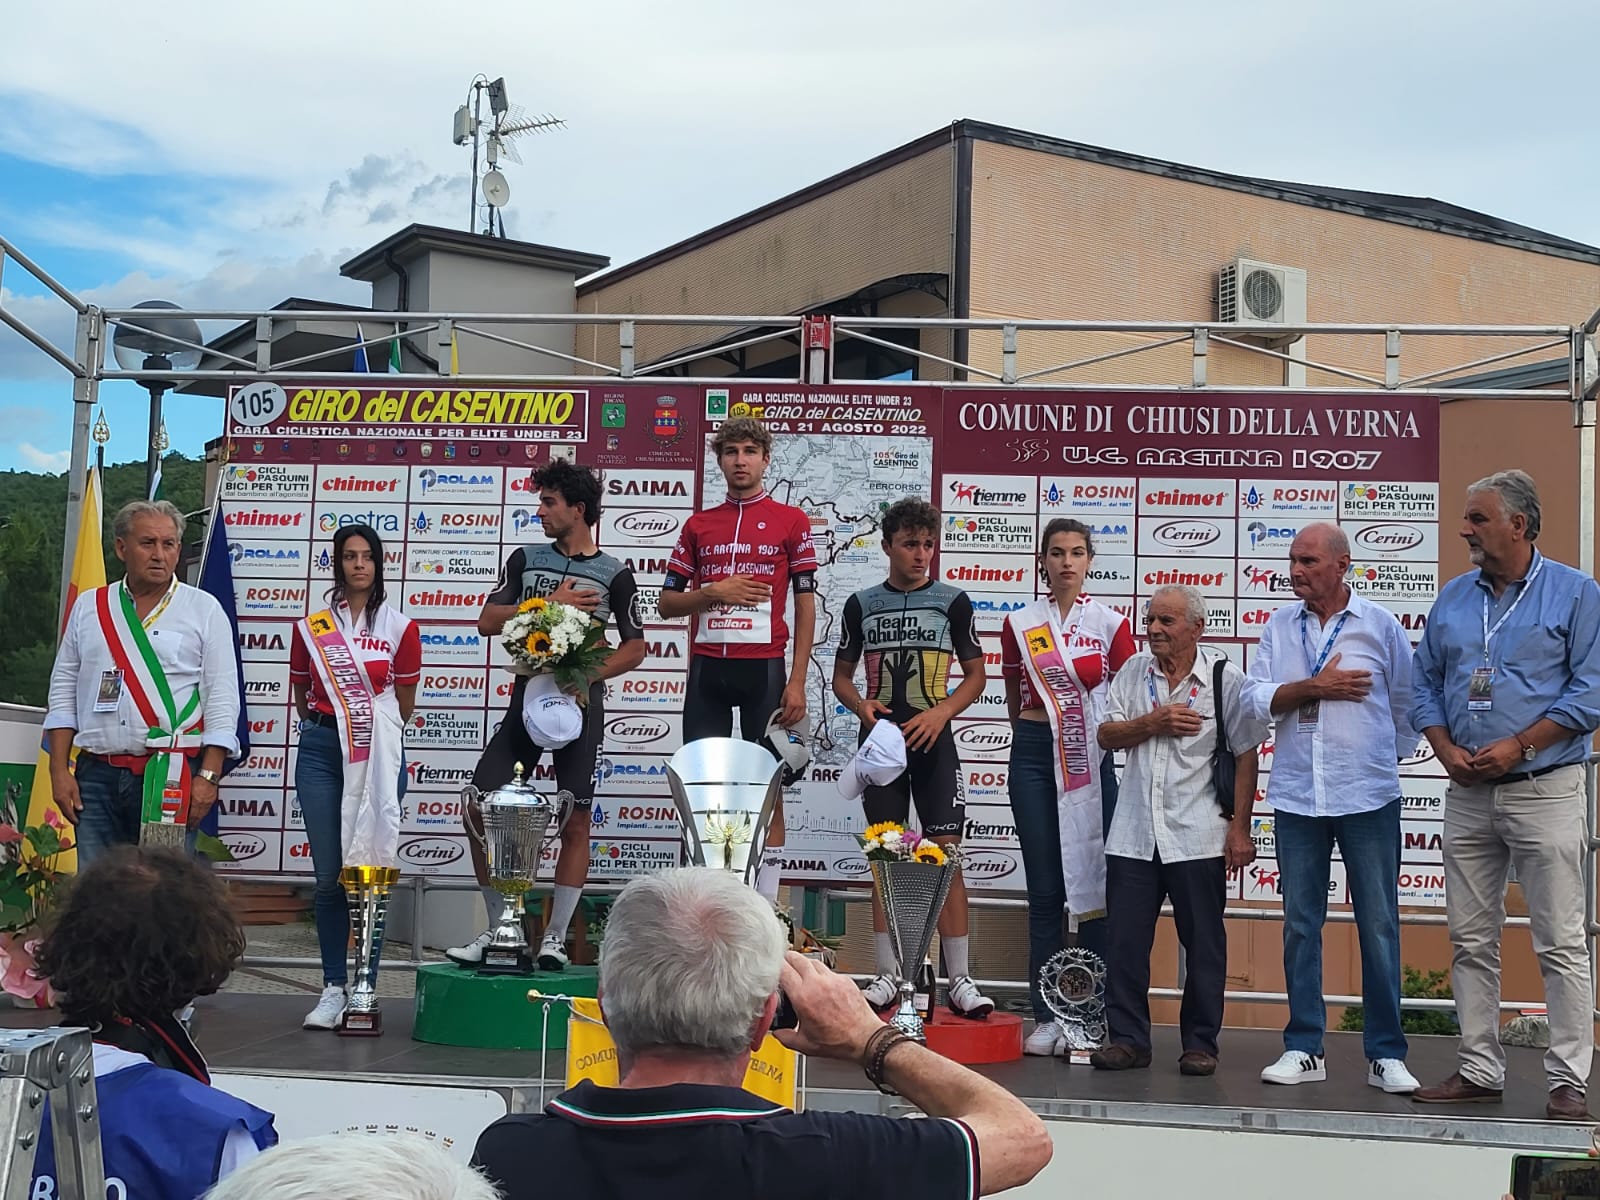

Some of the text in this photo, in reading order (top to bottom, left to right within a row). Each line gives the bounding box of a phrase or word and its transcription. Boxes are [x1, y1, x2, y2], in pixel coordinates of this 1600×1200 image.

[743, 393, 912, 406] GARA CICLISTICA NAZIONALE ELITE UNDER 23
[288, 389, 574, 425] GIRO del CASENTINO
[764, 406, 803, 418] GIRO
[806, 407, 829, 419] del
[831, 408, 922, 421] CASENTINO
[959, 402, 1421, 439] COMUNE DI CHIUSI DELLA VERNA
[234, 426, 582, 439] GARA CICLISTICA NAZIONALE PER ELITE UNDER 23
[797, 422, 927, 434] 21 AGOSTO 2022
[873, 459, 918, 467] CASENTINO
[1063, 446, 1383, 470] U.C. ARETINA 1907
[258, 473, 309, 482] PASQUINI
[322, 476, 397, 492] chimet
[226, 483, 309, 492] BICI PER TUTTI
[237, 490, 267, 498] bambino
[608, 480, 687, 496] SAIMA
[1073, 485, 1134, 499] ROSINI
[1379, 485, 1408, 493] CICLI
[974, 487, 1026, 506] tiemme
[1145, 489, 1225, 506] chimet
[1273, 488, 1336, 502] ROSINI
[1379, 493, 1434, 501] PASQUINI
[1344, 501, 1435, 511] BICI PER TUTTI
[224, 509, 300, 526] chimet
[339, 510, 399, 532] estra
[441, 514, 499, 526] ROSINI
[622, 515, 669, 532] Cerini
[978, 517, 1007, 525] CICLI
[978, 524, 1031, 533] PASQUINI
[1161, 523, 1212, 543] Cerini
[945, 533, 1032, 543] BICI PER TUTTI
[1364, 528, 1415, 546] Cerini
[758, 545, 779, 556] 1907
[449, 567, 495, 575] PASQUINI
[626, 558, 669, 574] AIM
[737, 563, 775, 576] CASENTINO
[1378, 565, 1408, 573] CICLI
[946, 565, 1025, 582] chimet
[1085, 571, 1118, 580] NGAS
[1144, 569, 1225, 586] chimet
[534, 574, 560, 590] Tea
[1372, 582, 1434, 591] PER TUTTI
[246, 588, 305, 601] ROSINI
[409, 589, 485, 606] chimet
[874, 615, 918, 629] Team
[868, 626, 936, 644] Qhubeka
[241, 634, 285, 650] IMA
[424, 676, 484, 689] ROSINI
[623, 680, 685, 693] ROSINI
[323, 645, 353, 666] GIRO
[342, 689, 374, 748] CASENTINO
[426, 712, 455, 720] CICLI
[1041, 665, 1089, 776] GIRO DEL CASENTINO
[426, 720, 478, 729] PASQUINI
[611, 722, 662, 737] Cerini
[405, 729, 478, 738] CI PER TUTTI
[960, 728, 1011, 745] Cerini
[417, 761, 473, 784] tiemme
[953, 769, 965, 808] Team
[218, 799, 275, 817] AIMA
[618, 807, 679, 820] ROSINI
[405, 843, 455, 859] Cerini
[621, 843, 650, 851] CICLI
[621, 851, 674, 859] PASQUINI
[615, 860, 637, 868] PER
[641, 860, 674, 869] TUTTI
[781, 859, 827, 871] SAIMA
[838, 862, 869, 870] Cerini
[576, 1047, 617, 1071] COMU
